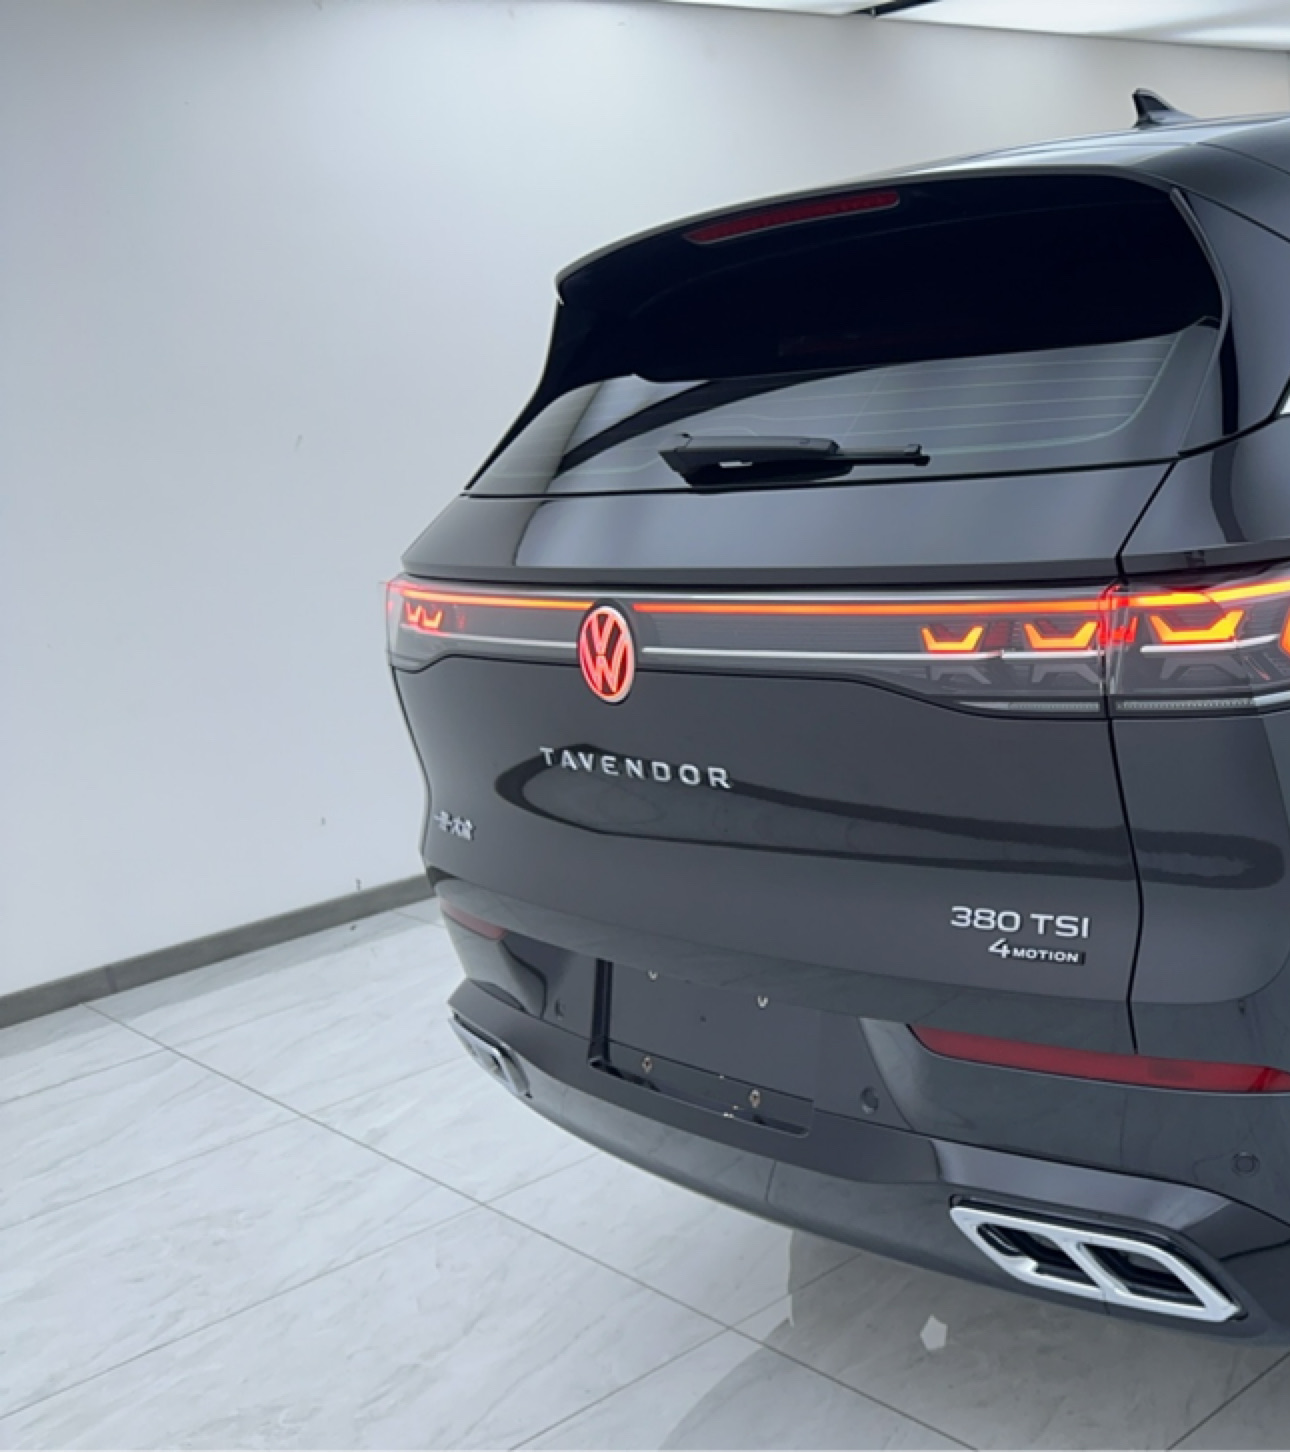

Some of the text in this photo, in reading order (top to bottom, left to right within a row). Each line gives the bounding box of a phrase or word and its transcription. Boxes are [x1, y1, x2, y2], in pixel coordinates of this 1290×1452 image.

[539, 745, 731, 790] TAVENDOR
[949, 904, 1090, 939] 380 TSI
